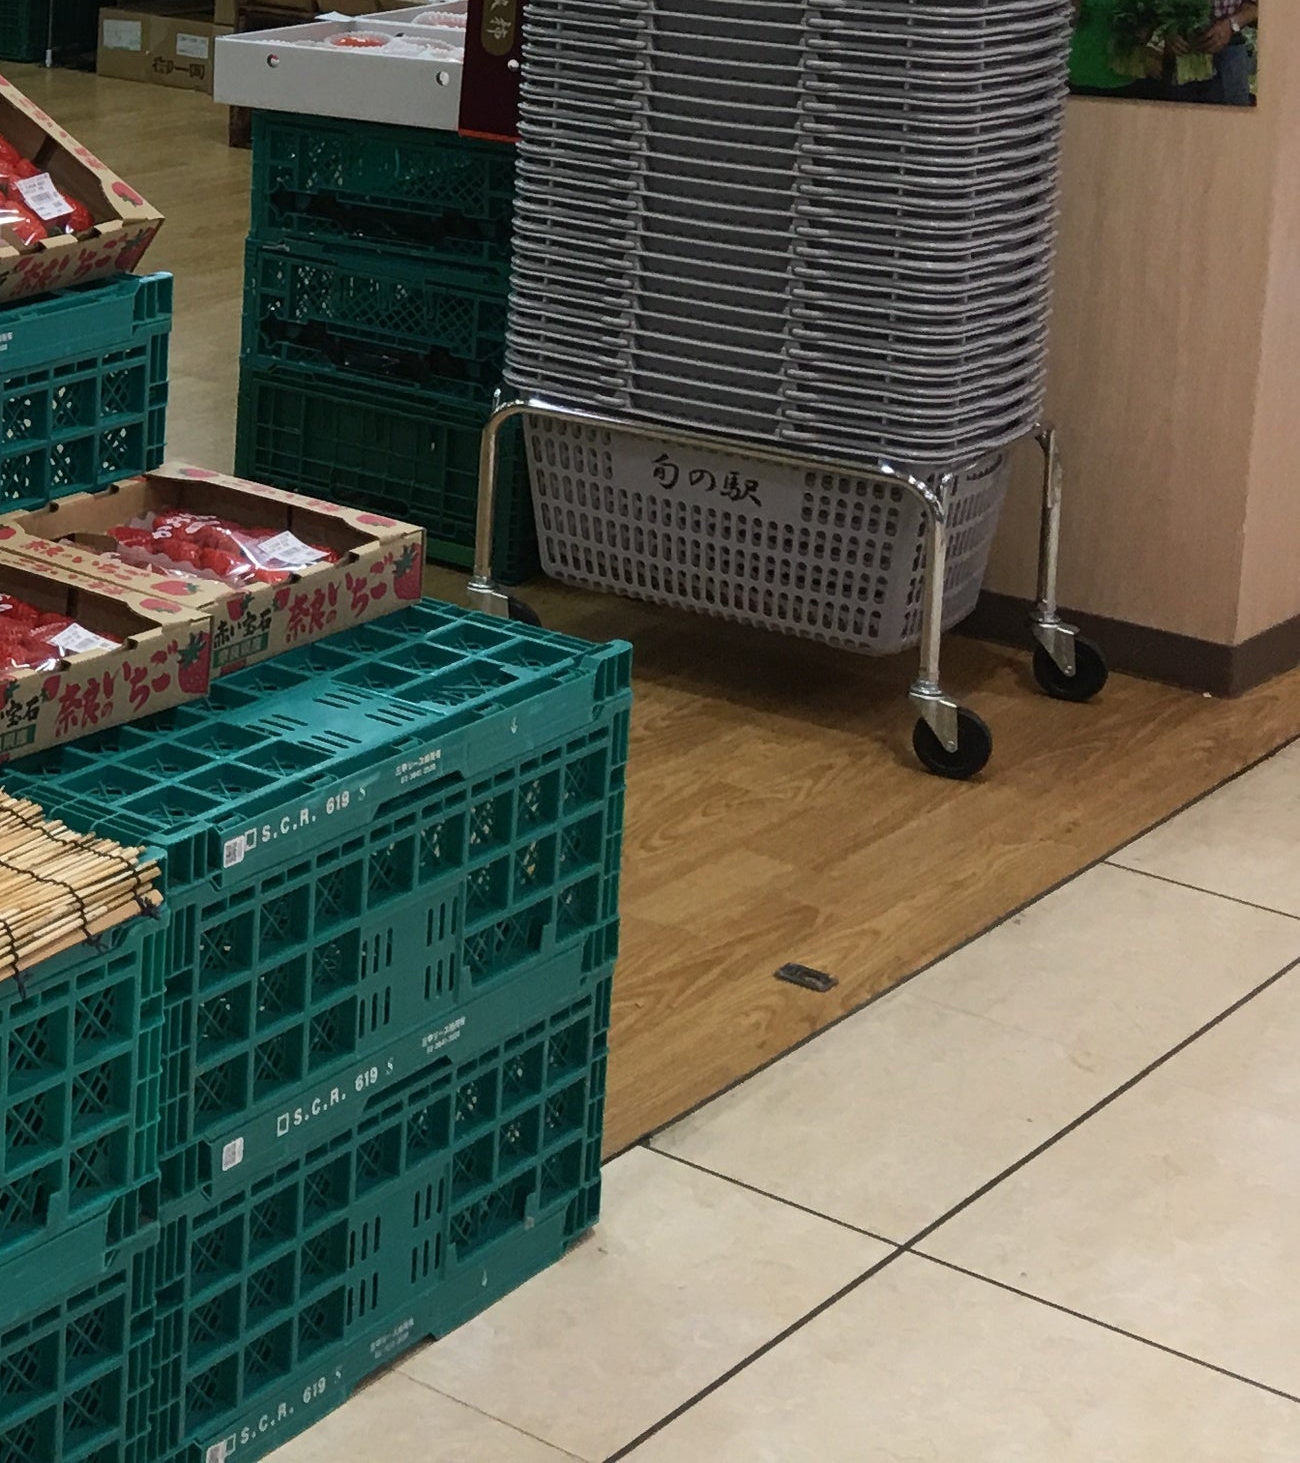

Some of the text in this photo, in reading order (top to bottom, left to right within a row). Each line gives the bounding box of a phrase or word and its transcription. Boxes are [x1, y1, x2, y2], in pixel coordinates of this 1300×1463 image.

[651, 453, 763, 508] 旬の駅
[214, 550, 396, 650] 赤い宝石 奈良のいちご
[55, 640, 180, 738] 奈良のいちご
[260, 808, 318, 844] S.C.R.
[325, 788, 352, 816] 619
[291, 1085, 348, 1127] S.C.R.
[354, 1065, 380, 1093] 619
[237, 1395, 297, 1447] S.C.R.
[301, 1374, 330, 1406] 619
